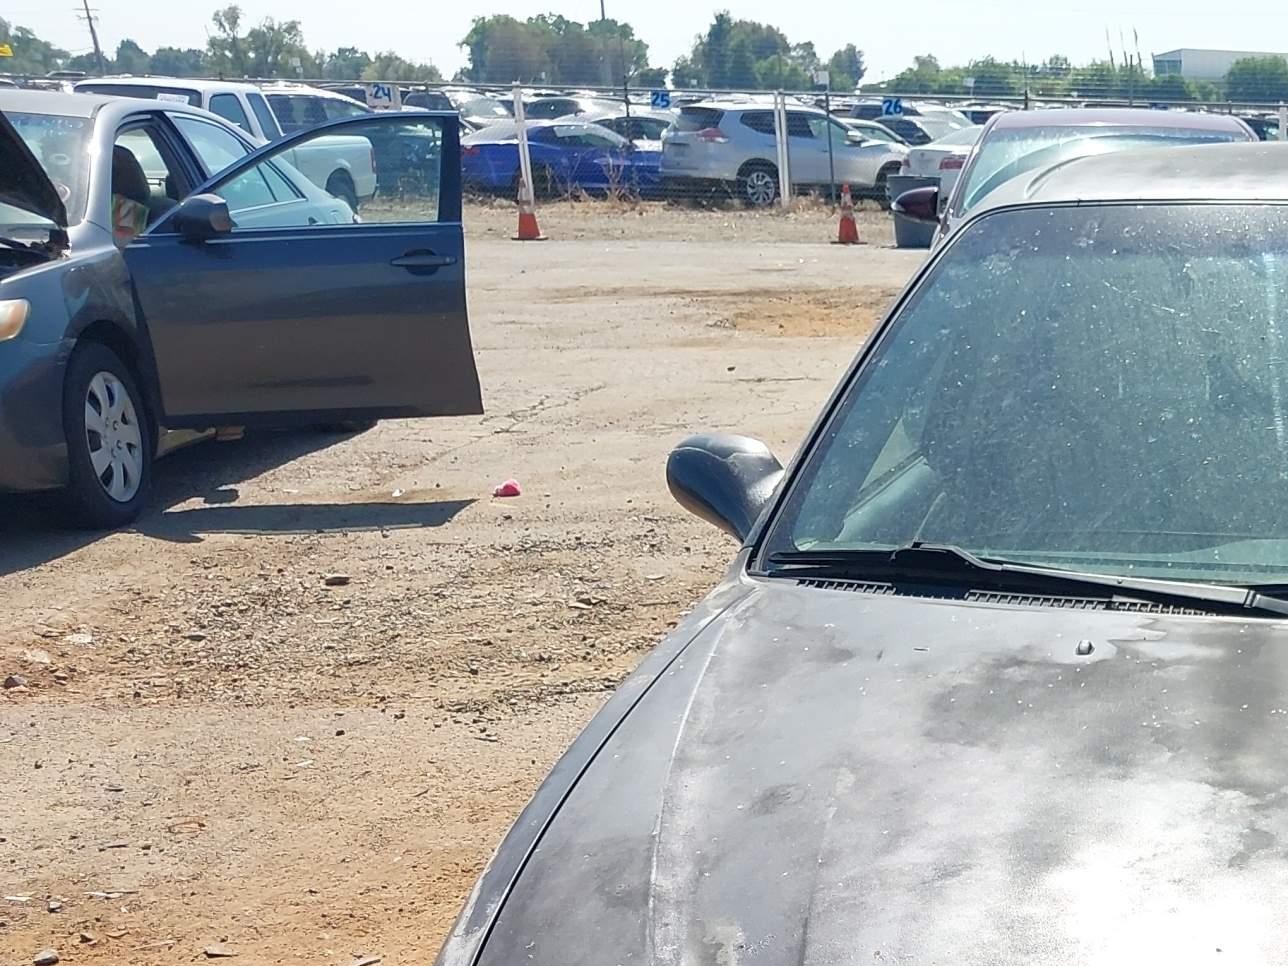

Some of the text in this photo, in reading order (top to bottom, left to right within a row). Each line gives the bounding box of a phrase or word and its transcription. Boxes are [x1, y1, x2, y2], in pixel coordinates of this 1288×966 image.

[373, 84, 392, 102] 24
[651, 90, 670, 108] 25
[883, 98, 902, 115] 26
